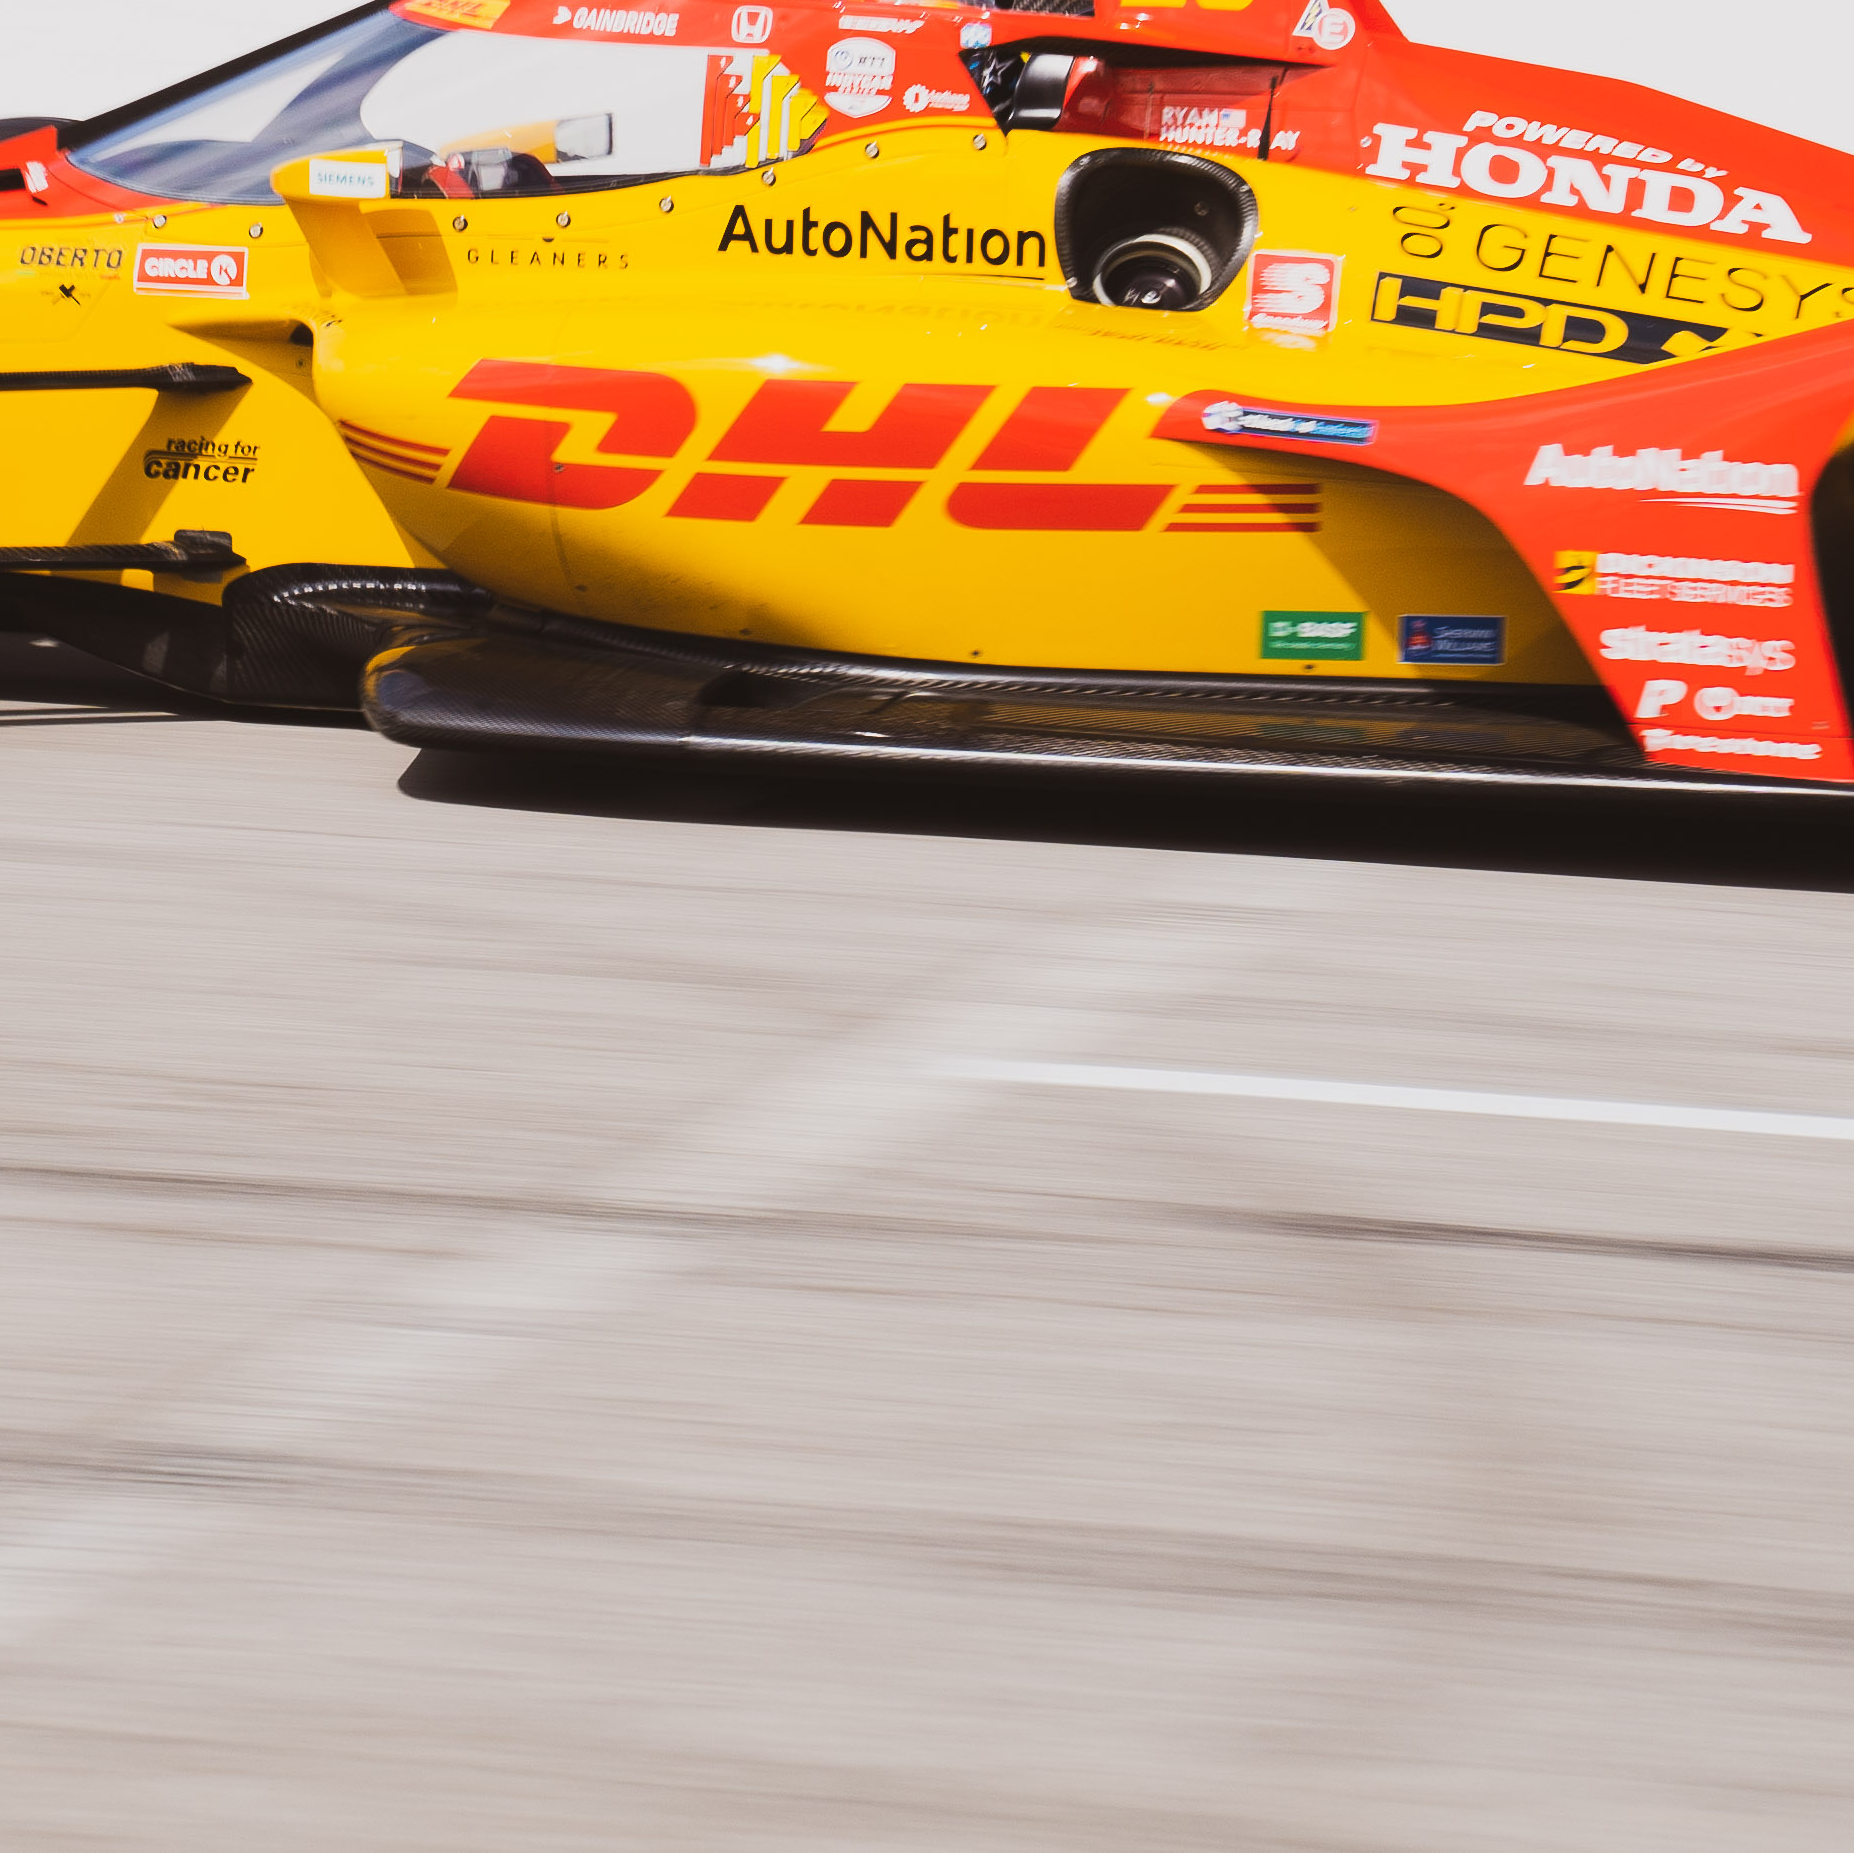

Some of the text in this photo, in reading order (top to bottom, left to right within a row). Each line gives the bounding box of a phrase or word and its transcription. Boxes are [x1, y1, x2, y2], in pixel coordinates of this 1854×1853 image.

[573, 6, 679, 37] GAINBRIDGE
[1161, 106, 1219, 128] RYAN
[1463, 109, 1728, 179] POWERED by
[316, 170, 376, 188] SIEMENS
[1365, 122, 1813, 245] HONDA
[719, 204, 1046, 268] AutoNation
[20, 246, 123, 269] OBERTO
[144, 256, 209, 279] CIRCLE
[467, 248, 629, 269] GLEANERS
[1373, 275, 1630, 353] HPD
[166, 435, 261, 458] racing for
[447, 358, 1176, 532] DHL
[144, 458, 255, 484] cancer
[1523, 443, 1800, 498] AutoNation
